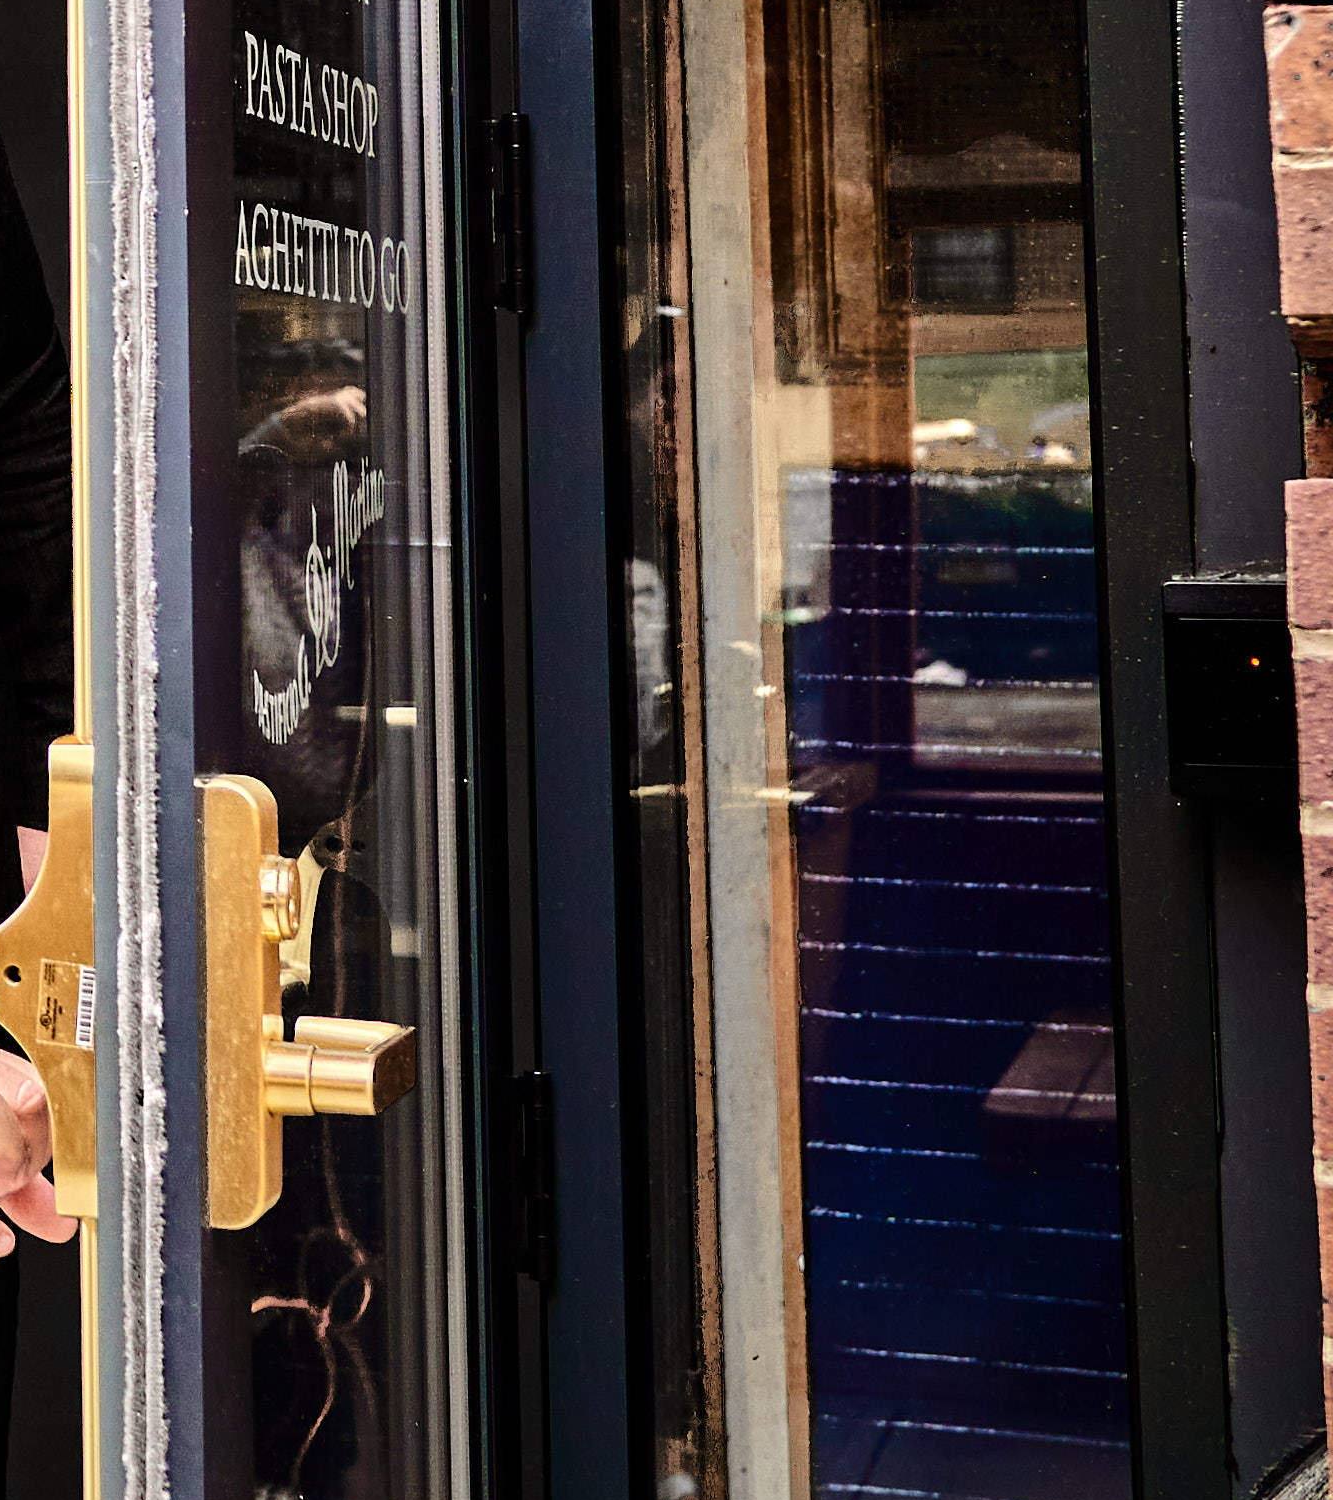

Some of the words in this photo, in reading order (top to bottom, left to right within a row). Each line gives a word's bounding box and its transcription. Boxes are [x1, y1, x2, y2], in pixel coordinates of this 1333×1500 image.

[245, 31, 317, 138] PASTA
[321, 64, 379, 158] SHOP
[235, 200, 341, 303] AGHETTI
[345, 227, 376, 309] TO
[380, 236, 411, 315] GO
